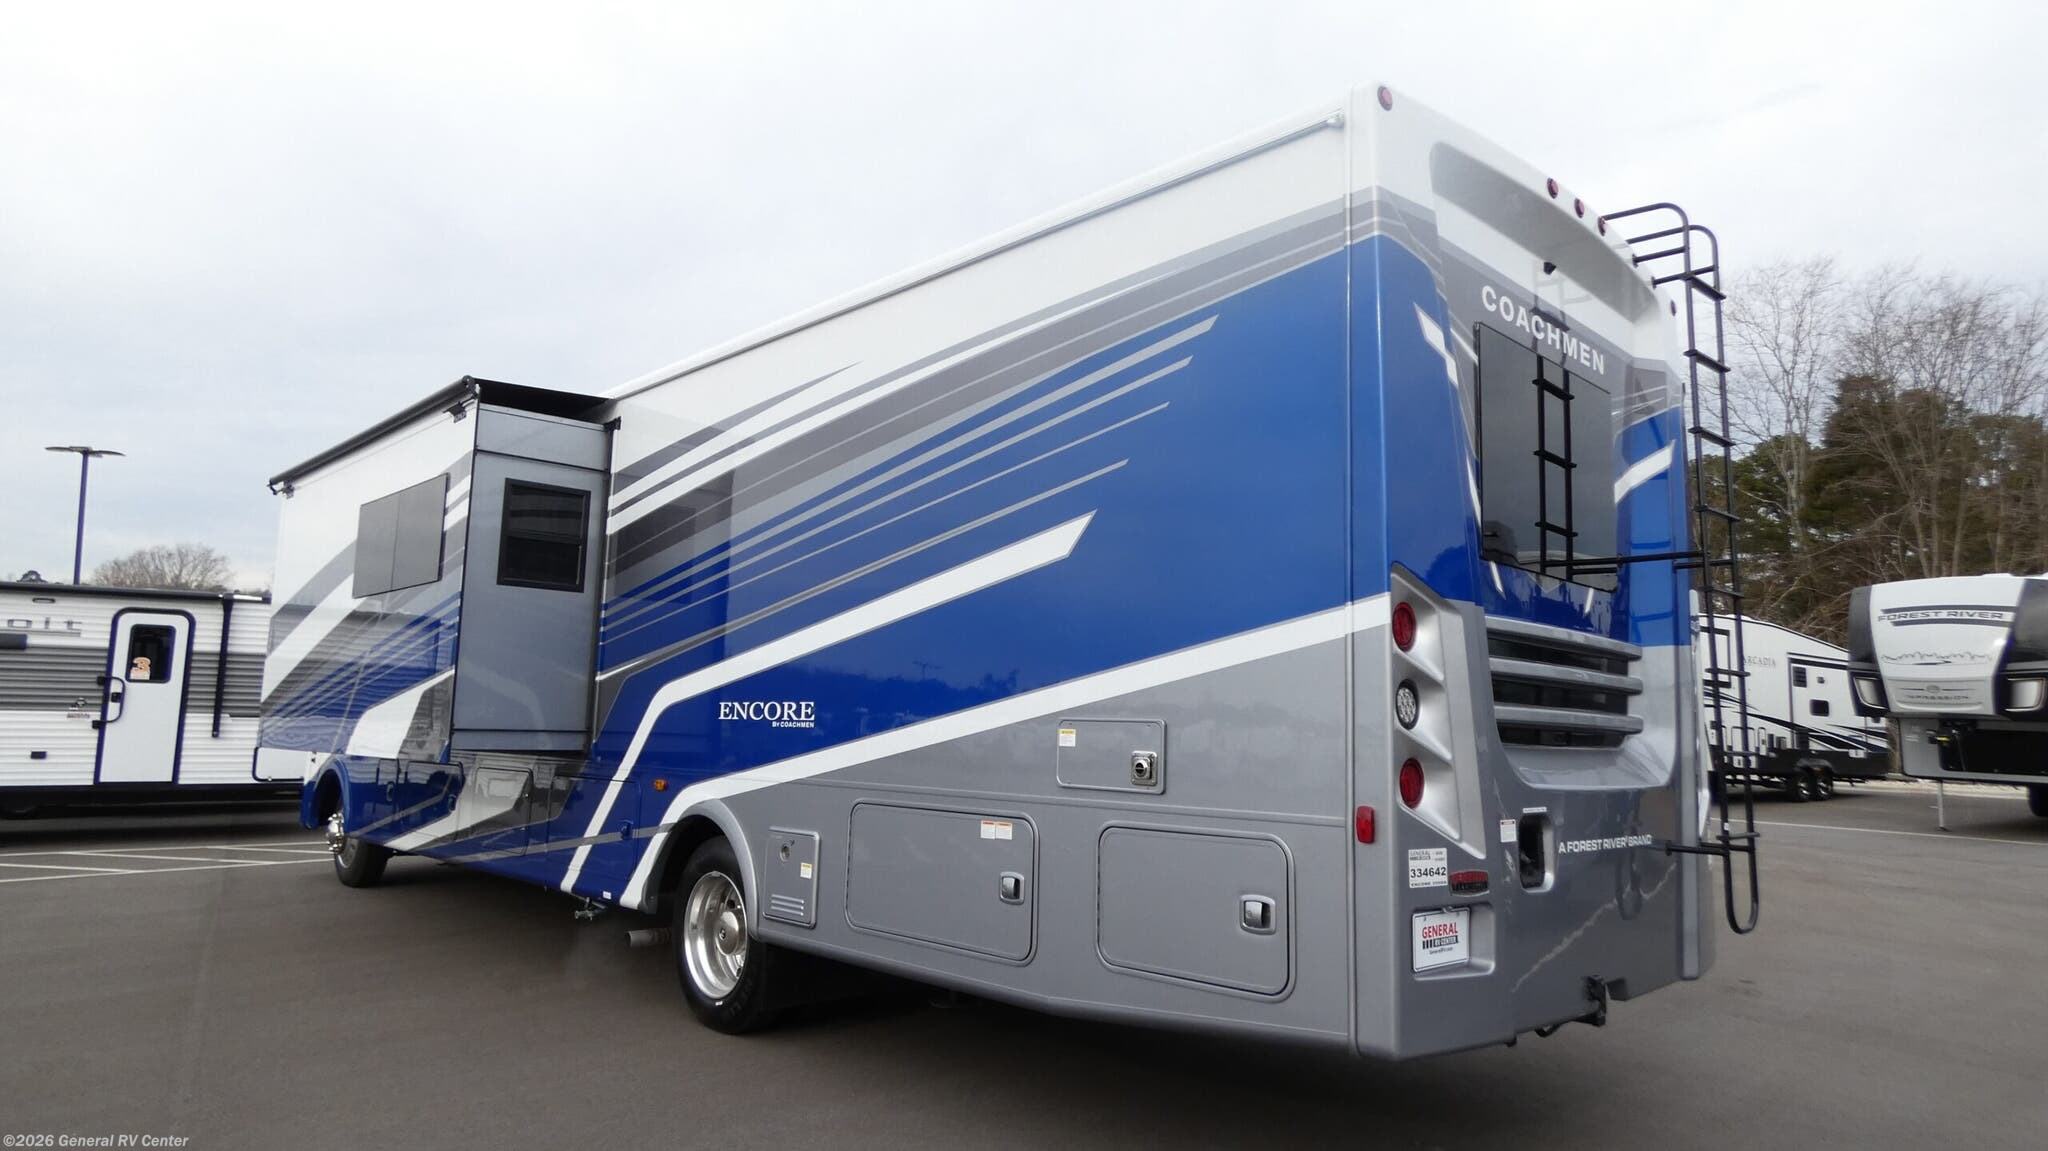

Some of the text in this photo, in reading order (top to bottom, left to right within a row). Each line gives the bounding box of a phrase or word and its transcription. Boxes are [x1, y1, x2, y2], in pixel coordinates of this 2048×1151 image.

[1482, 285, 1604, 376] COACHMEN
[1878, 611, 2003, 622] FOREST RIVER
[718, 701, 815, 721] ENCORE
[1558, 842, 1567, 854] A
[1567, 838, 1603, 853] FOREST
[1629, 834, 1653, 847] BRAND
[1410, 866, 1447, 879] 334642
[1422, 922, 1458, 939] GENERAL
